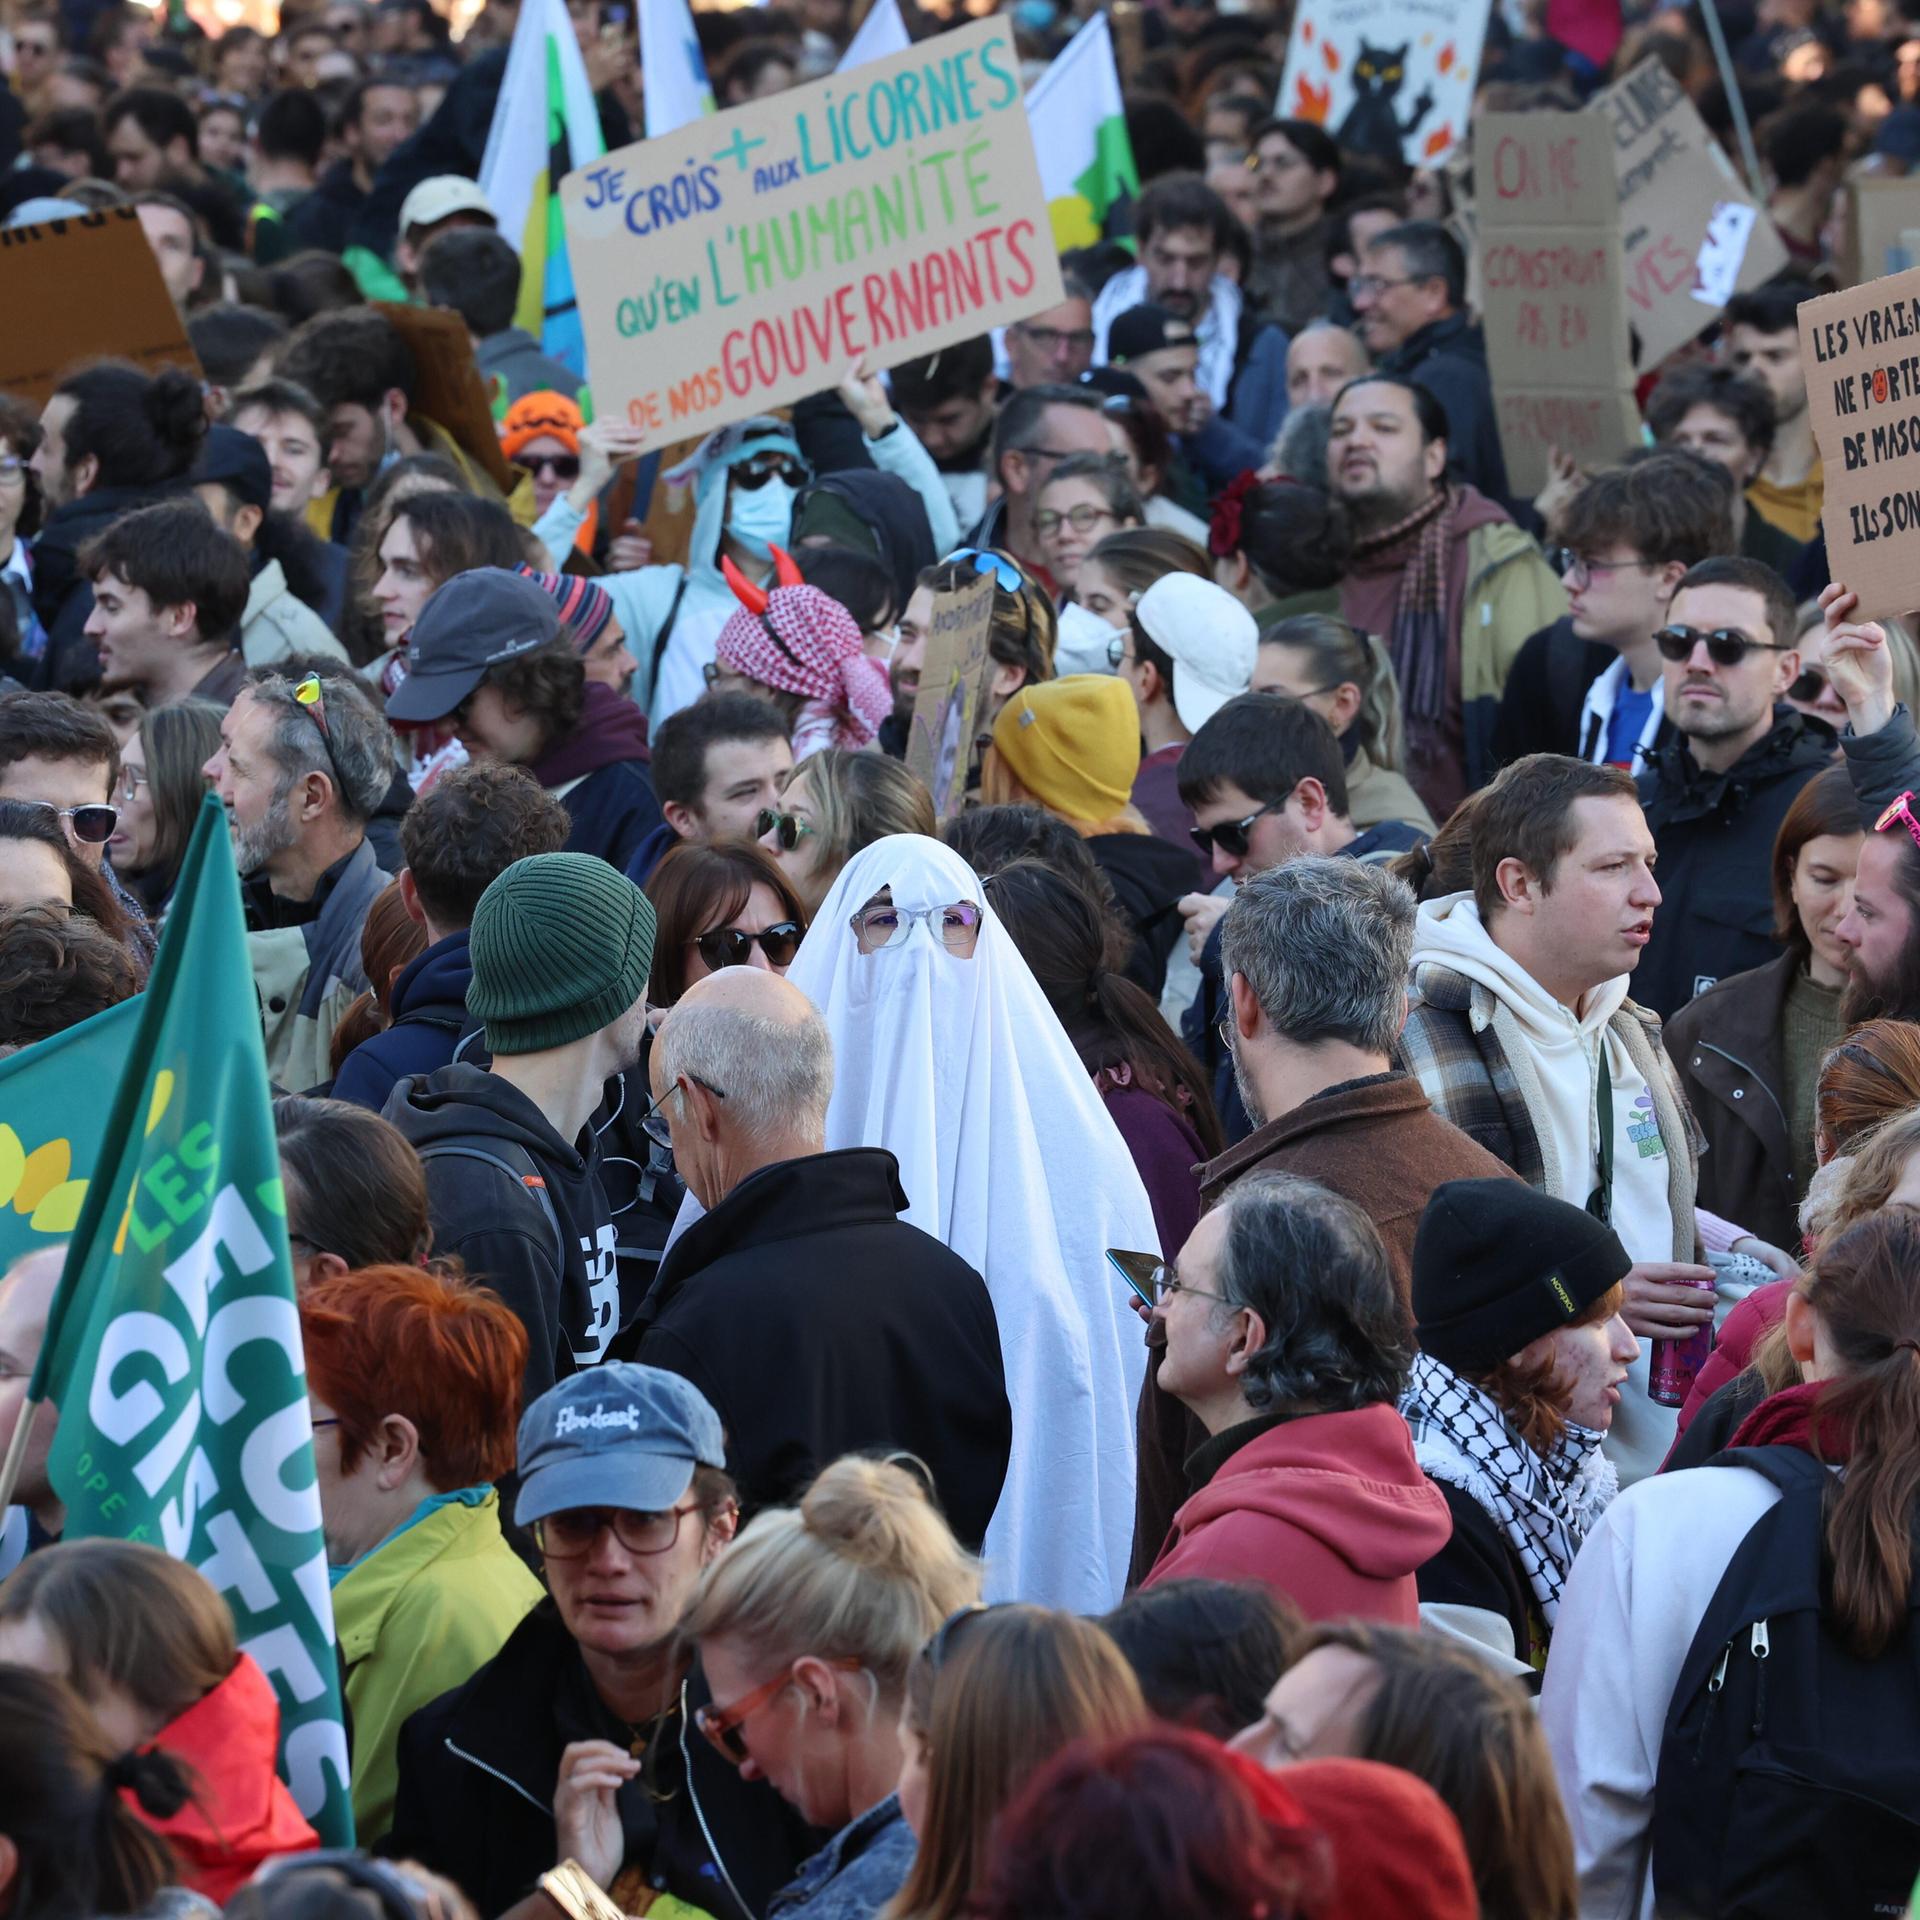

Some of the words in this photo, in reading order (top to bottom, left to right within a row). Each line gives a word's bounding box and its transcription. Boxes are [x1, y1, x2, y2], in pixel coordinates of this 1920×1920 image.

[584, 169, 626, 210] JE
[753, 157, 800, 195] AUX
[616, 276, 701, 339] QU'EN
[628, 398, 663, 431] DE
[667, 366, 723, 421] NOS
[721, 219, 1036, 398] GOUVERNANTS
[1813, 320, 1849, 363] LES
[1834, 375, 1858, 417] NE
[1843, 431, 1868, 471] DE
[127, 1120, 221, 1254] LES
